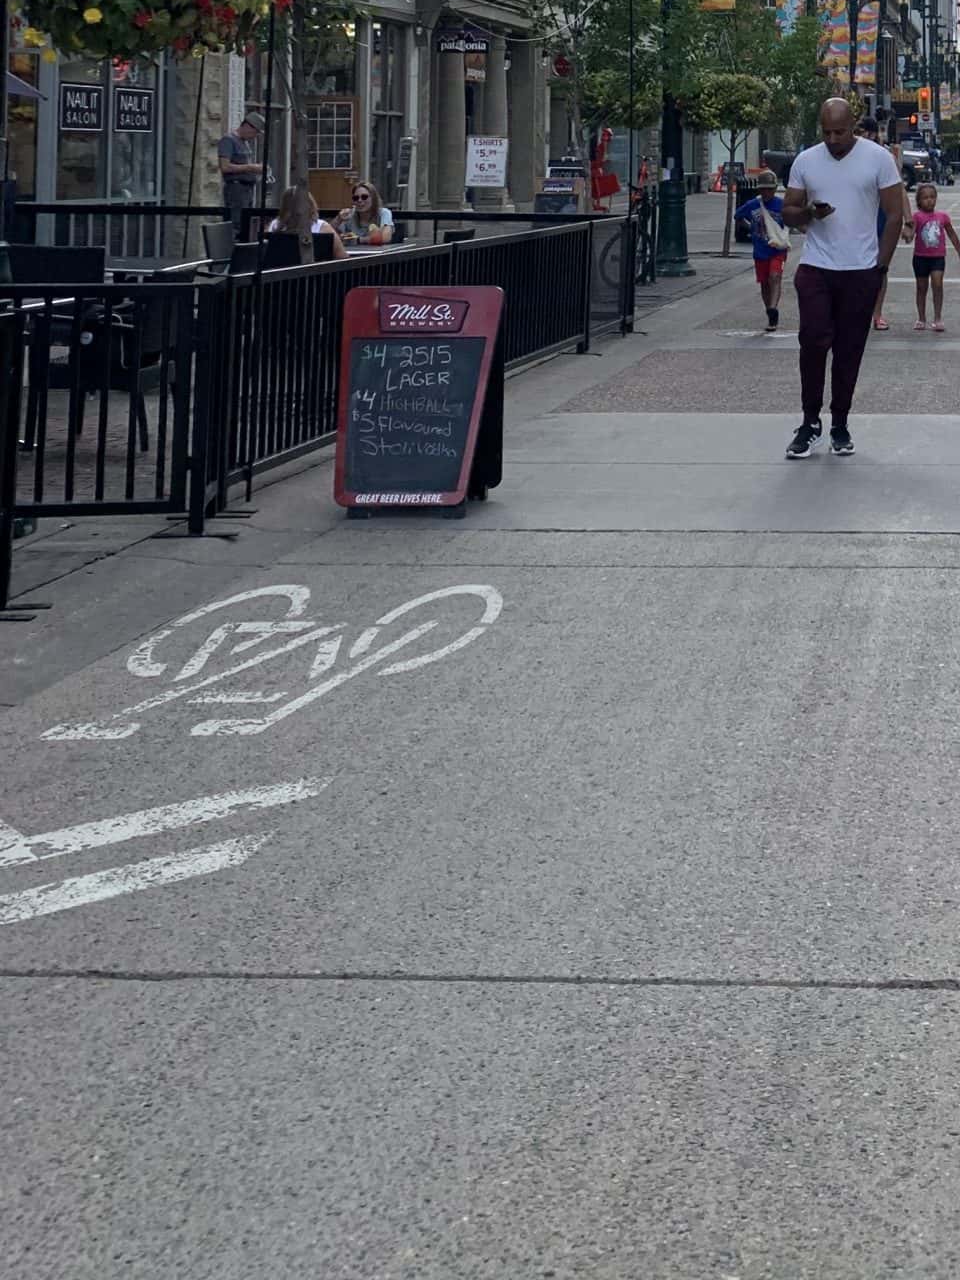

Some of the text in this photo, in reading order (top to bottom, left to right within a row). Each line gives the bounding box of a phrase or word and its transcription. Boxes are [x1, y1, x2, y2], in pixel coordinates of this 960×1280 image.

[66, 91, 98, 109] NAIL IT
[120, 95, 149, 112] NAIL IT
[66, 111, 97, 124] SALON
[120, 113, 148, 126] SALON
[388, 304, 455, 321] Mill St.
[386, 368, 450, 391] LAGER
[378, 415, 452, 436] Flavoured
[355, 493, 378, 504] GREAT
[379, 494, 399, 504] BEER
[400, 494, 421, 504] LIVES
